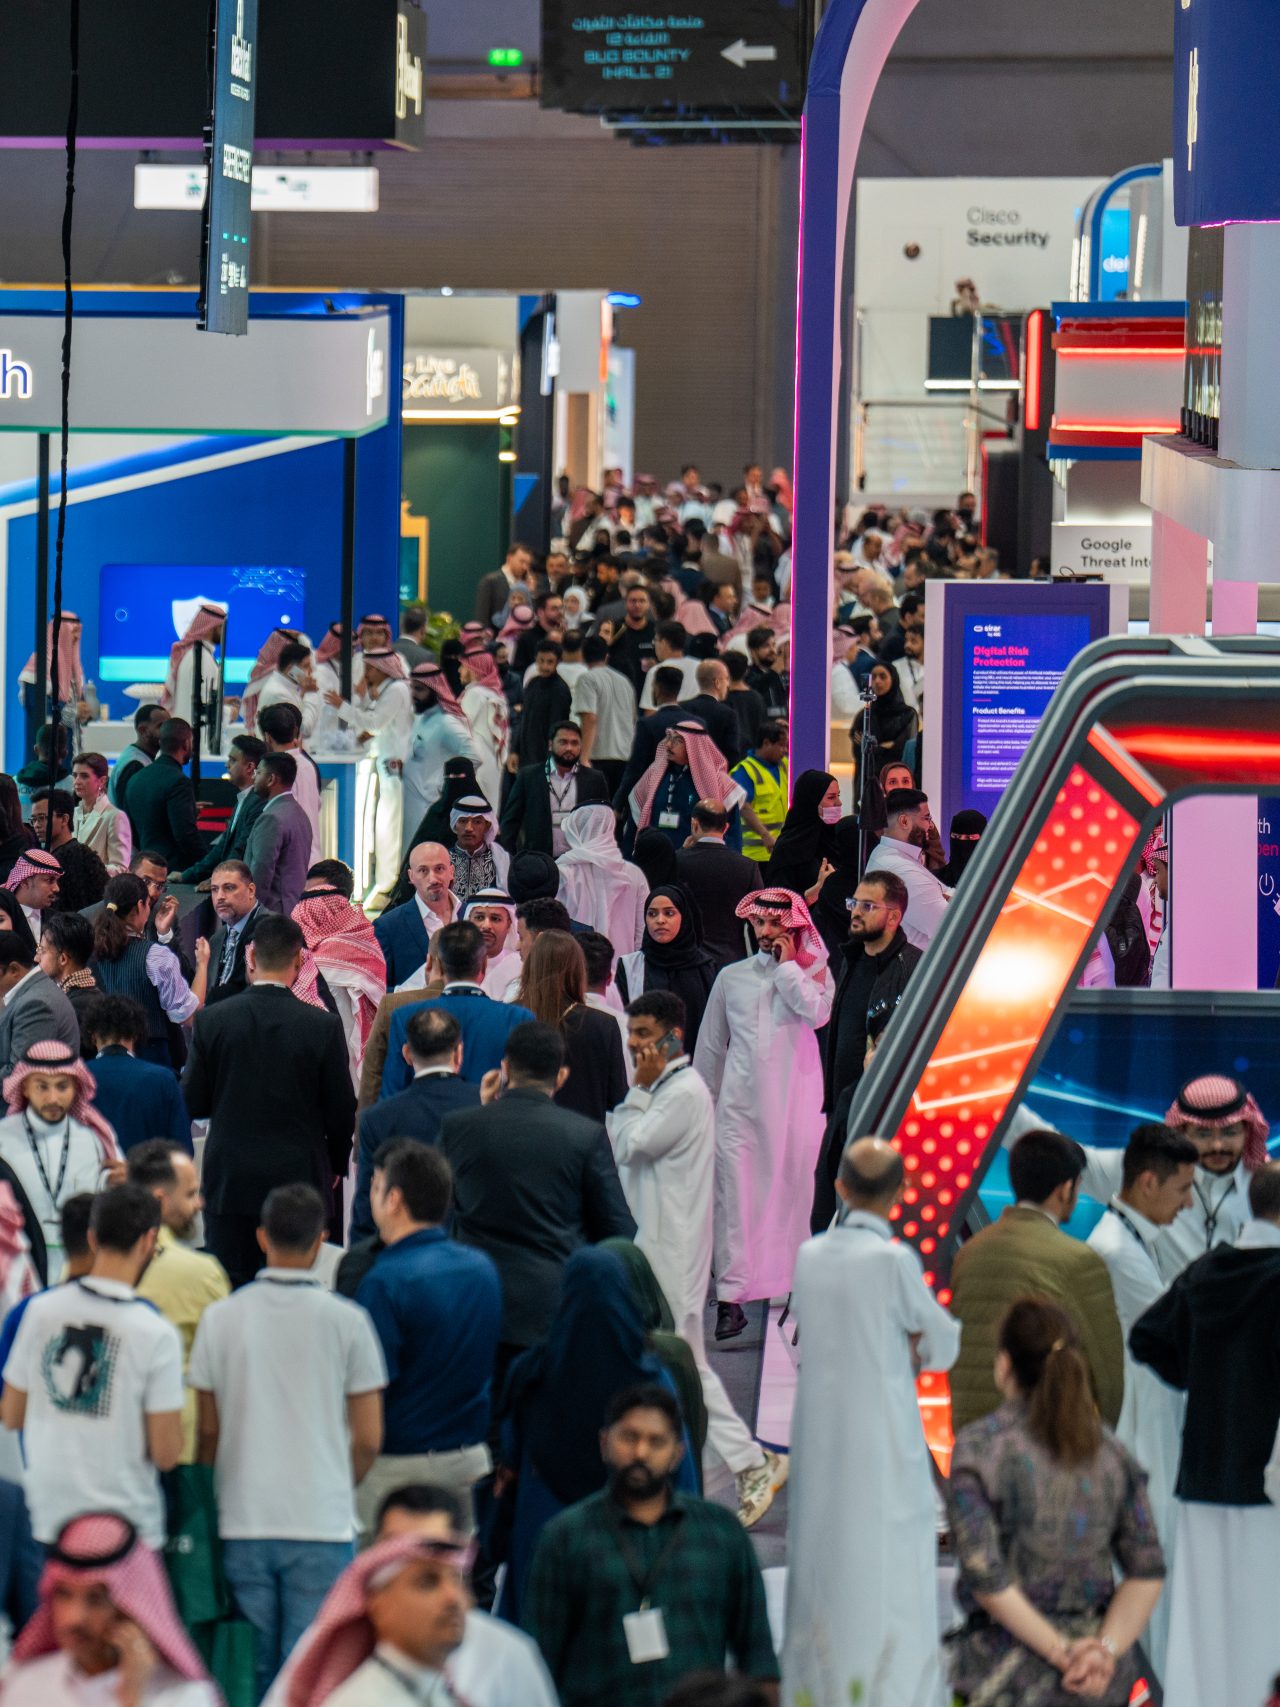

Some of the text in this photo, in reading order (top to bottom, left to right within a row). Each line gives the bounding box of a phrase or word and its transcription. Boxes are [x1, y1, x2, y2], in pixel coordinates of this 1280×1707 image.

[622, 48, 691, 63] BOUNTY
[967, 206, 1019, 225] Cisco
[967, 230, 1049, 250] Security
[1081, 537, 1132, 553] Google
[1080, 555, 1126, 568] Threat
[973, 646, 1029, 656] Digital Risk
[973, 657, 1025, 666] Protection
[972, 707, 1025, 715] Product Benefits
